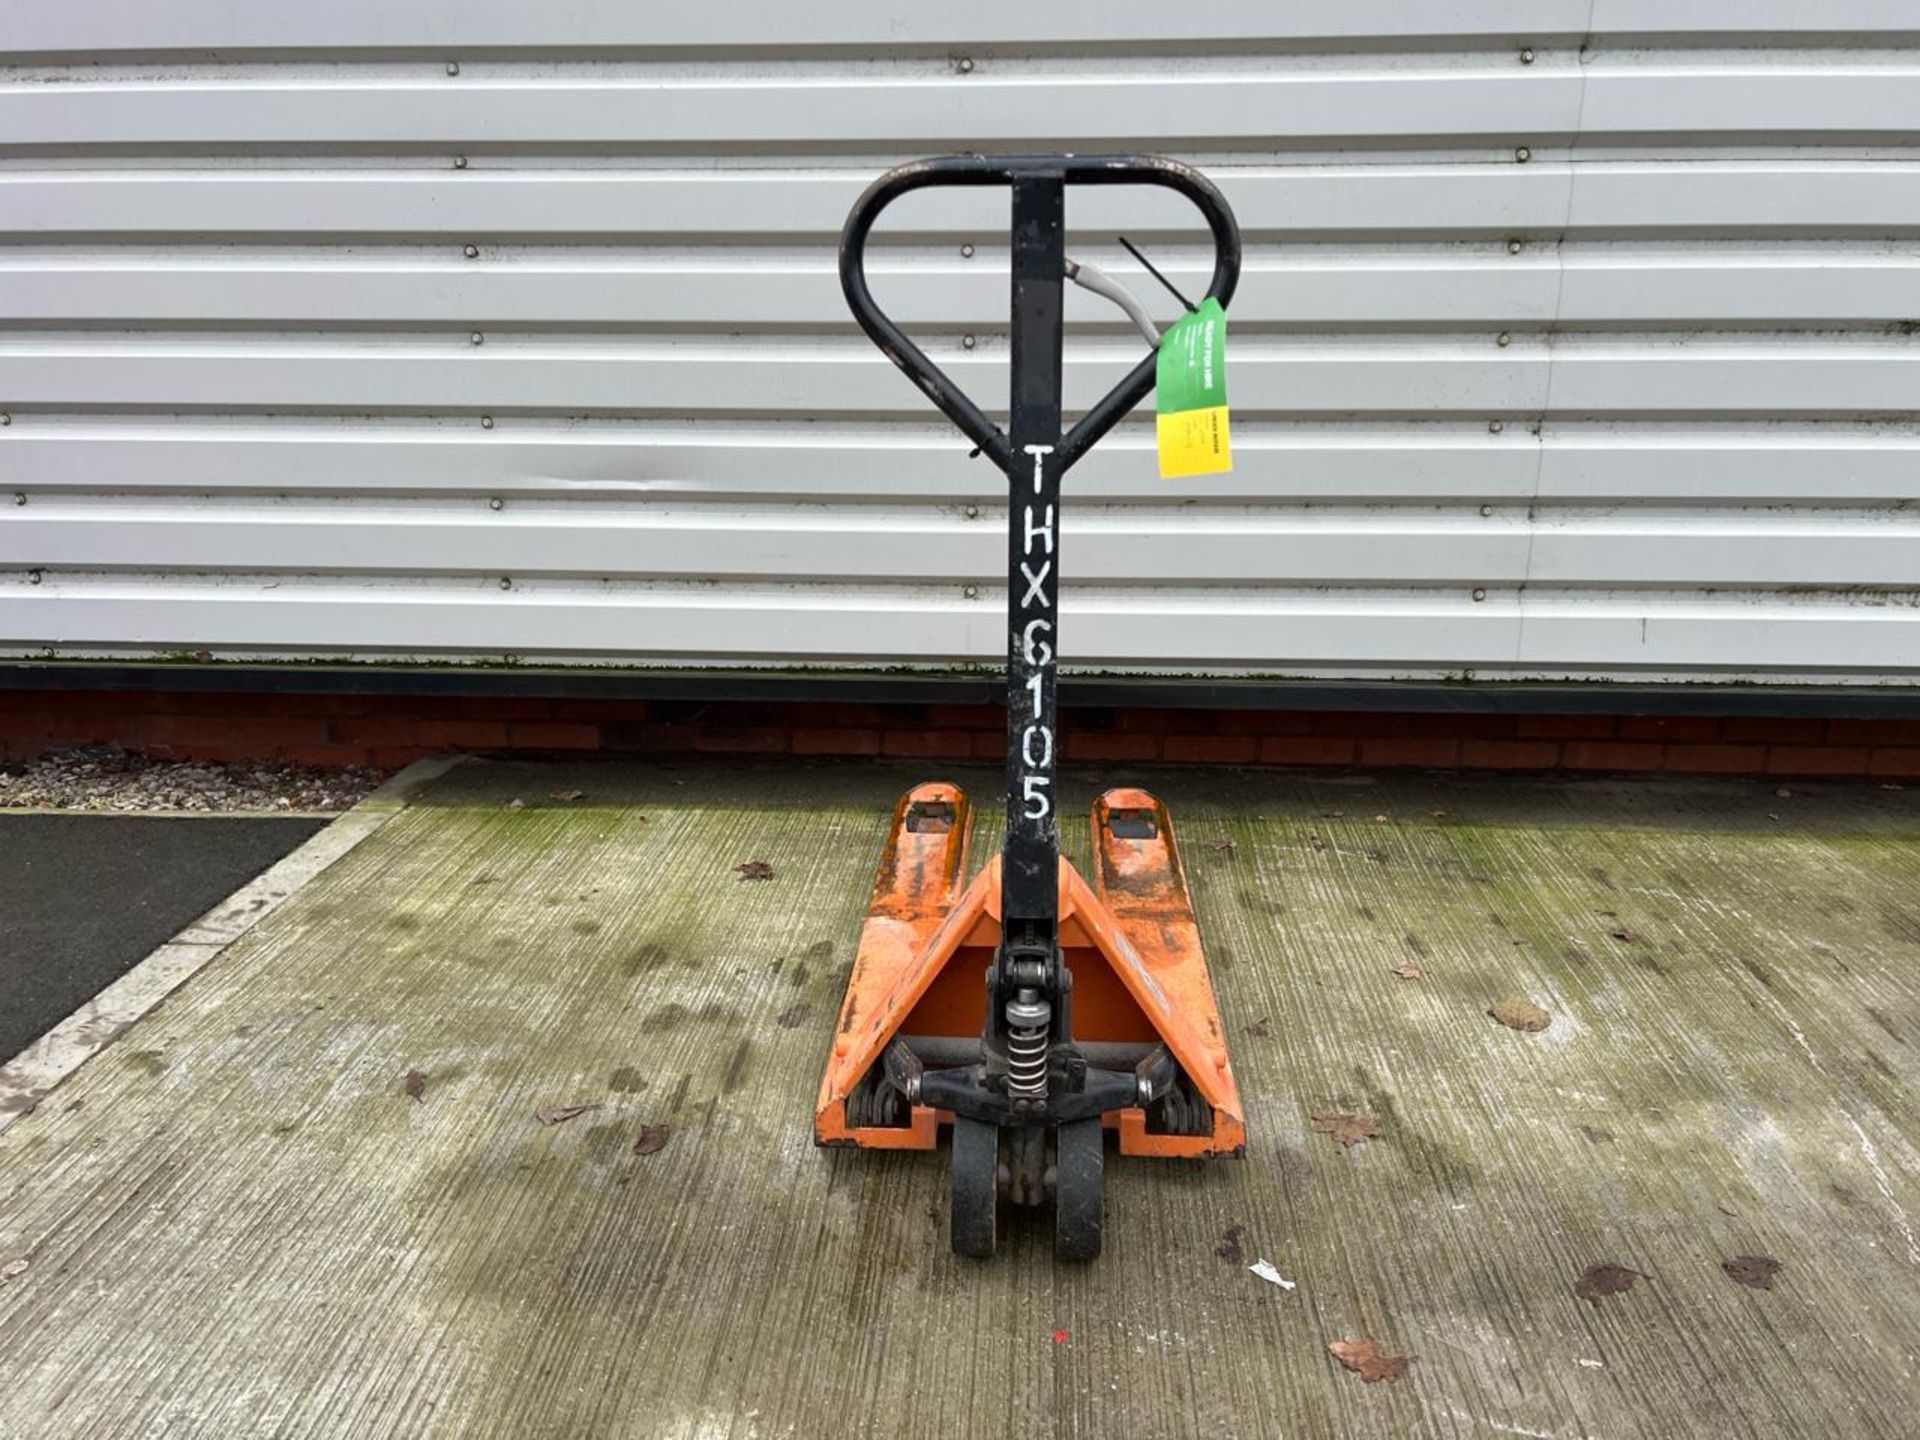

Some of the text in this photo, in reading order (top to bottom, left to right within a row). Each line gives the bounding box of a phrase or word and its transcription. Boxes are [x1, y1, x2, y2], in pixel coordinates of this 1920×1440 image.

[1204, 319, 1215, 389] READY FOR HIRE
[1020, 444, 1054, 819] THX6105
